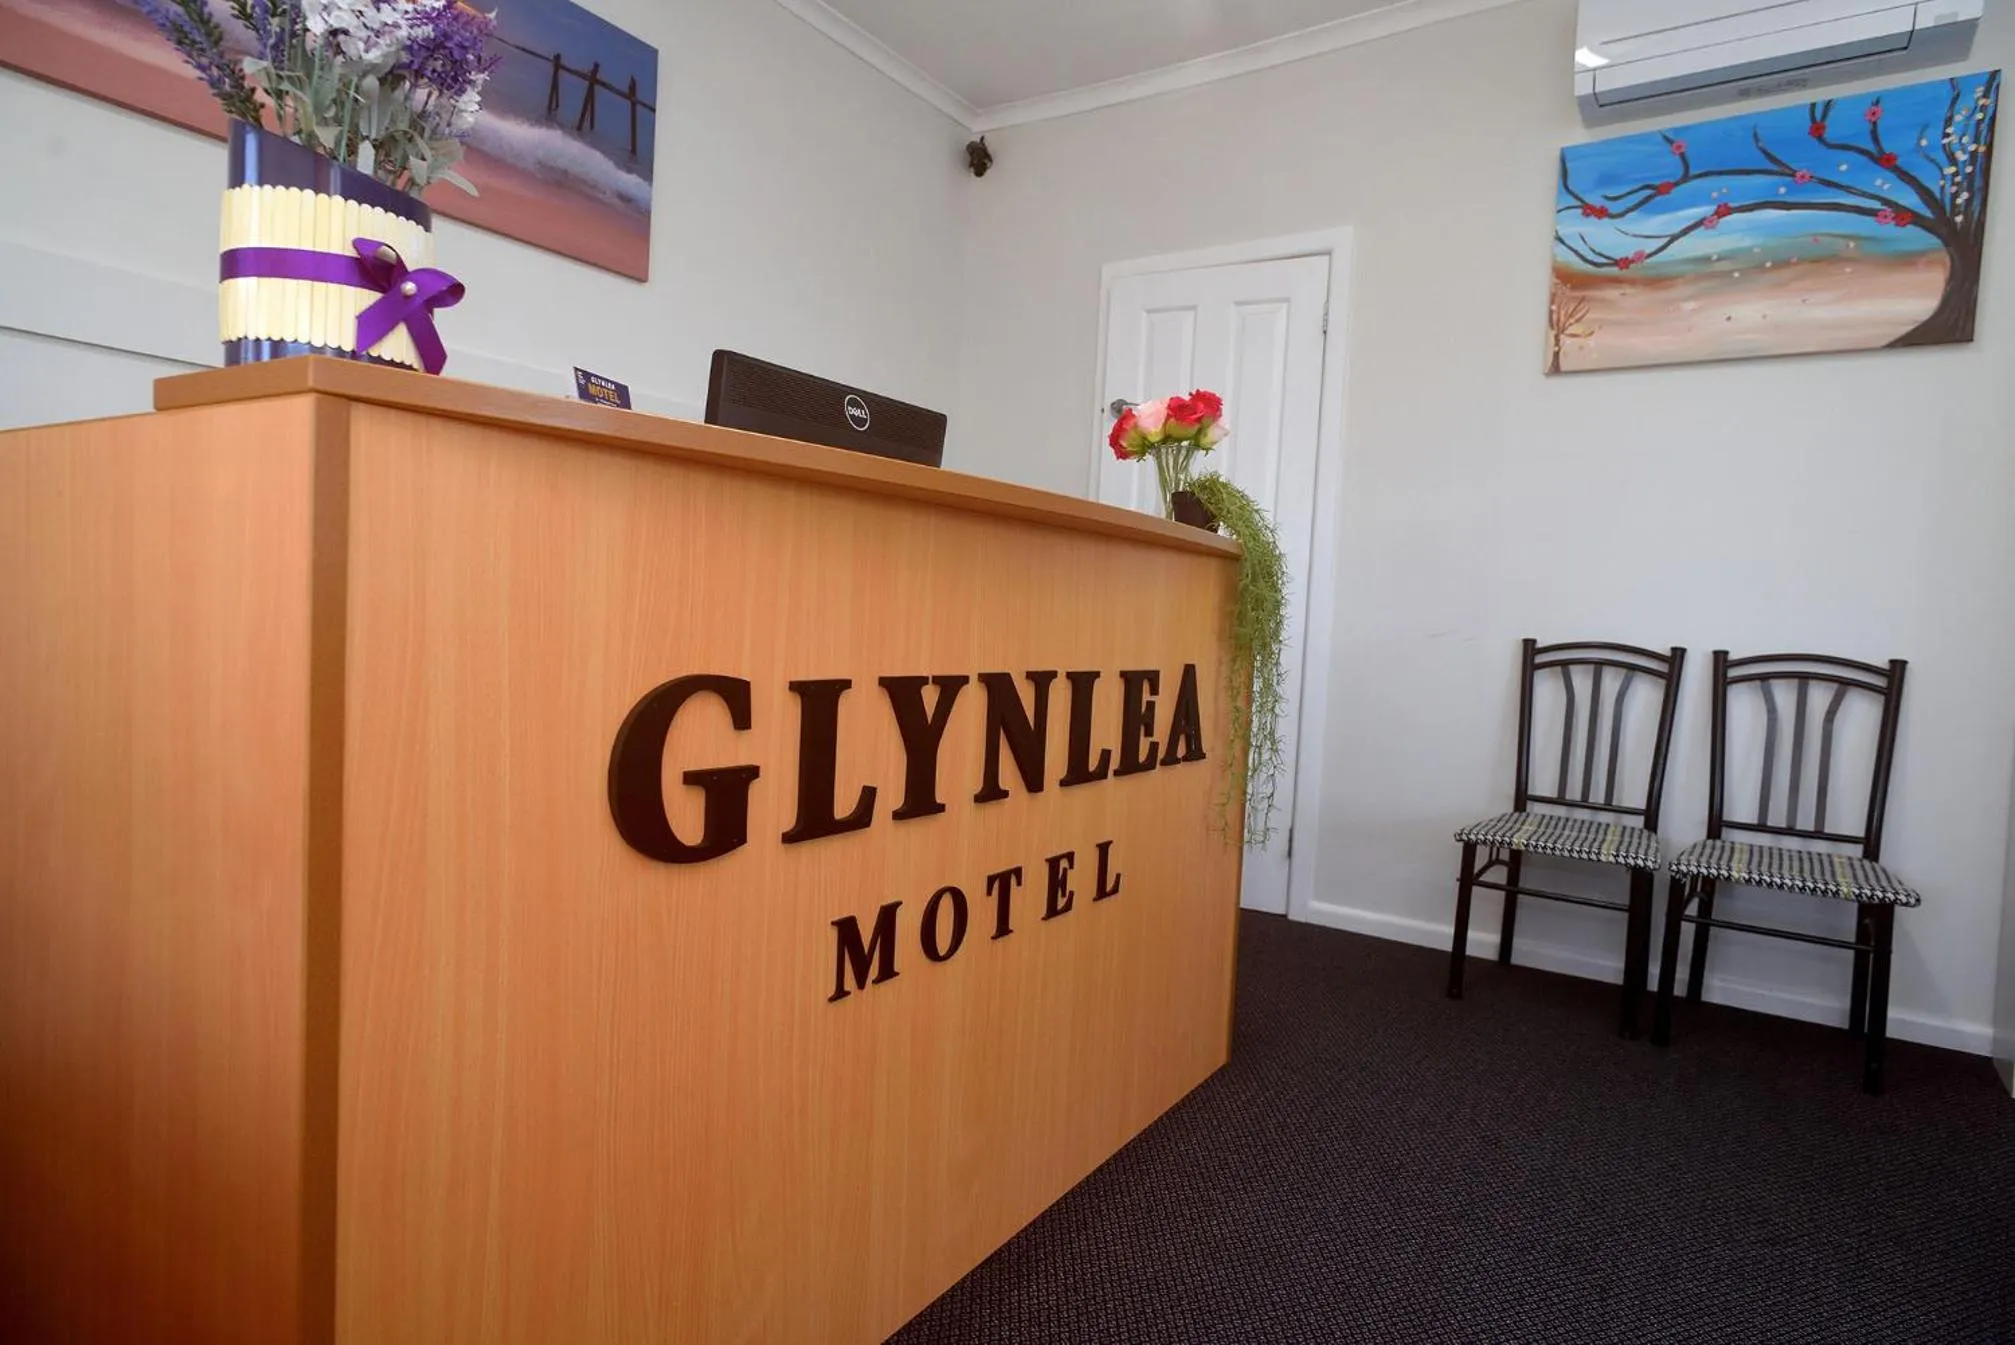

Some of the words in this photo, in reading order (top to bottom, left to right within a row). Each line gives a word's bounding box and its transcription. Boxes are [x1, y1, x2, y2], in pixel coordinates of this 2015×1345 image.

[588, 383, 620, 403] MOTEL
[847, 405, 867, 419] DELL
[608, 663, 1206, 864] GLYNLEA
[827, 840, 1121, 1003] MOTEL
